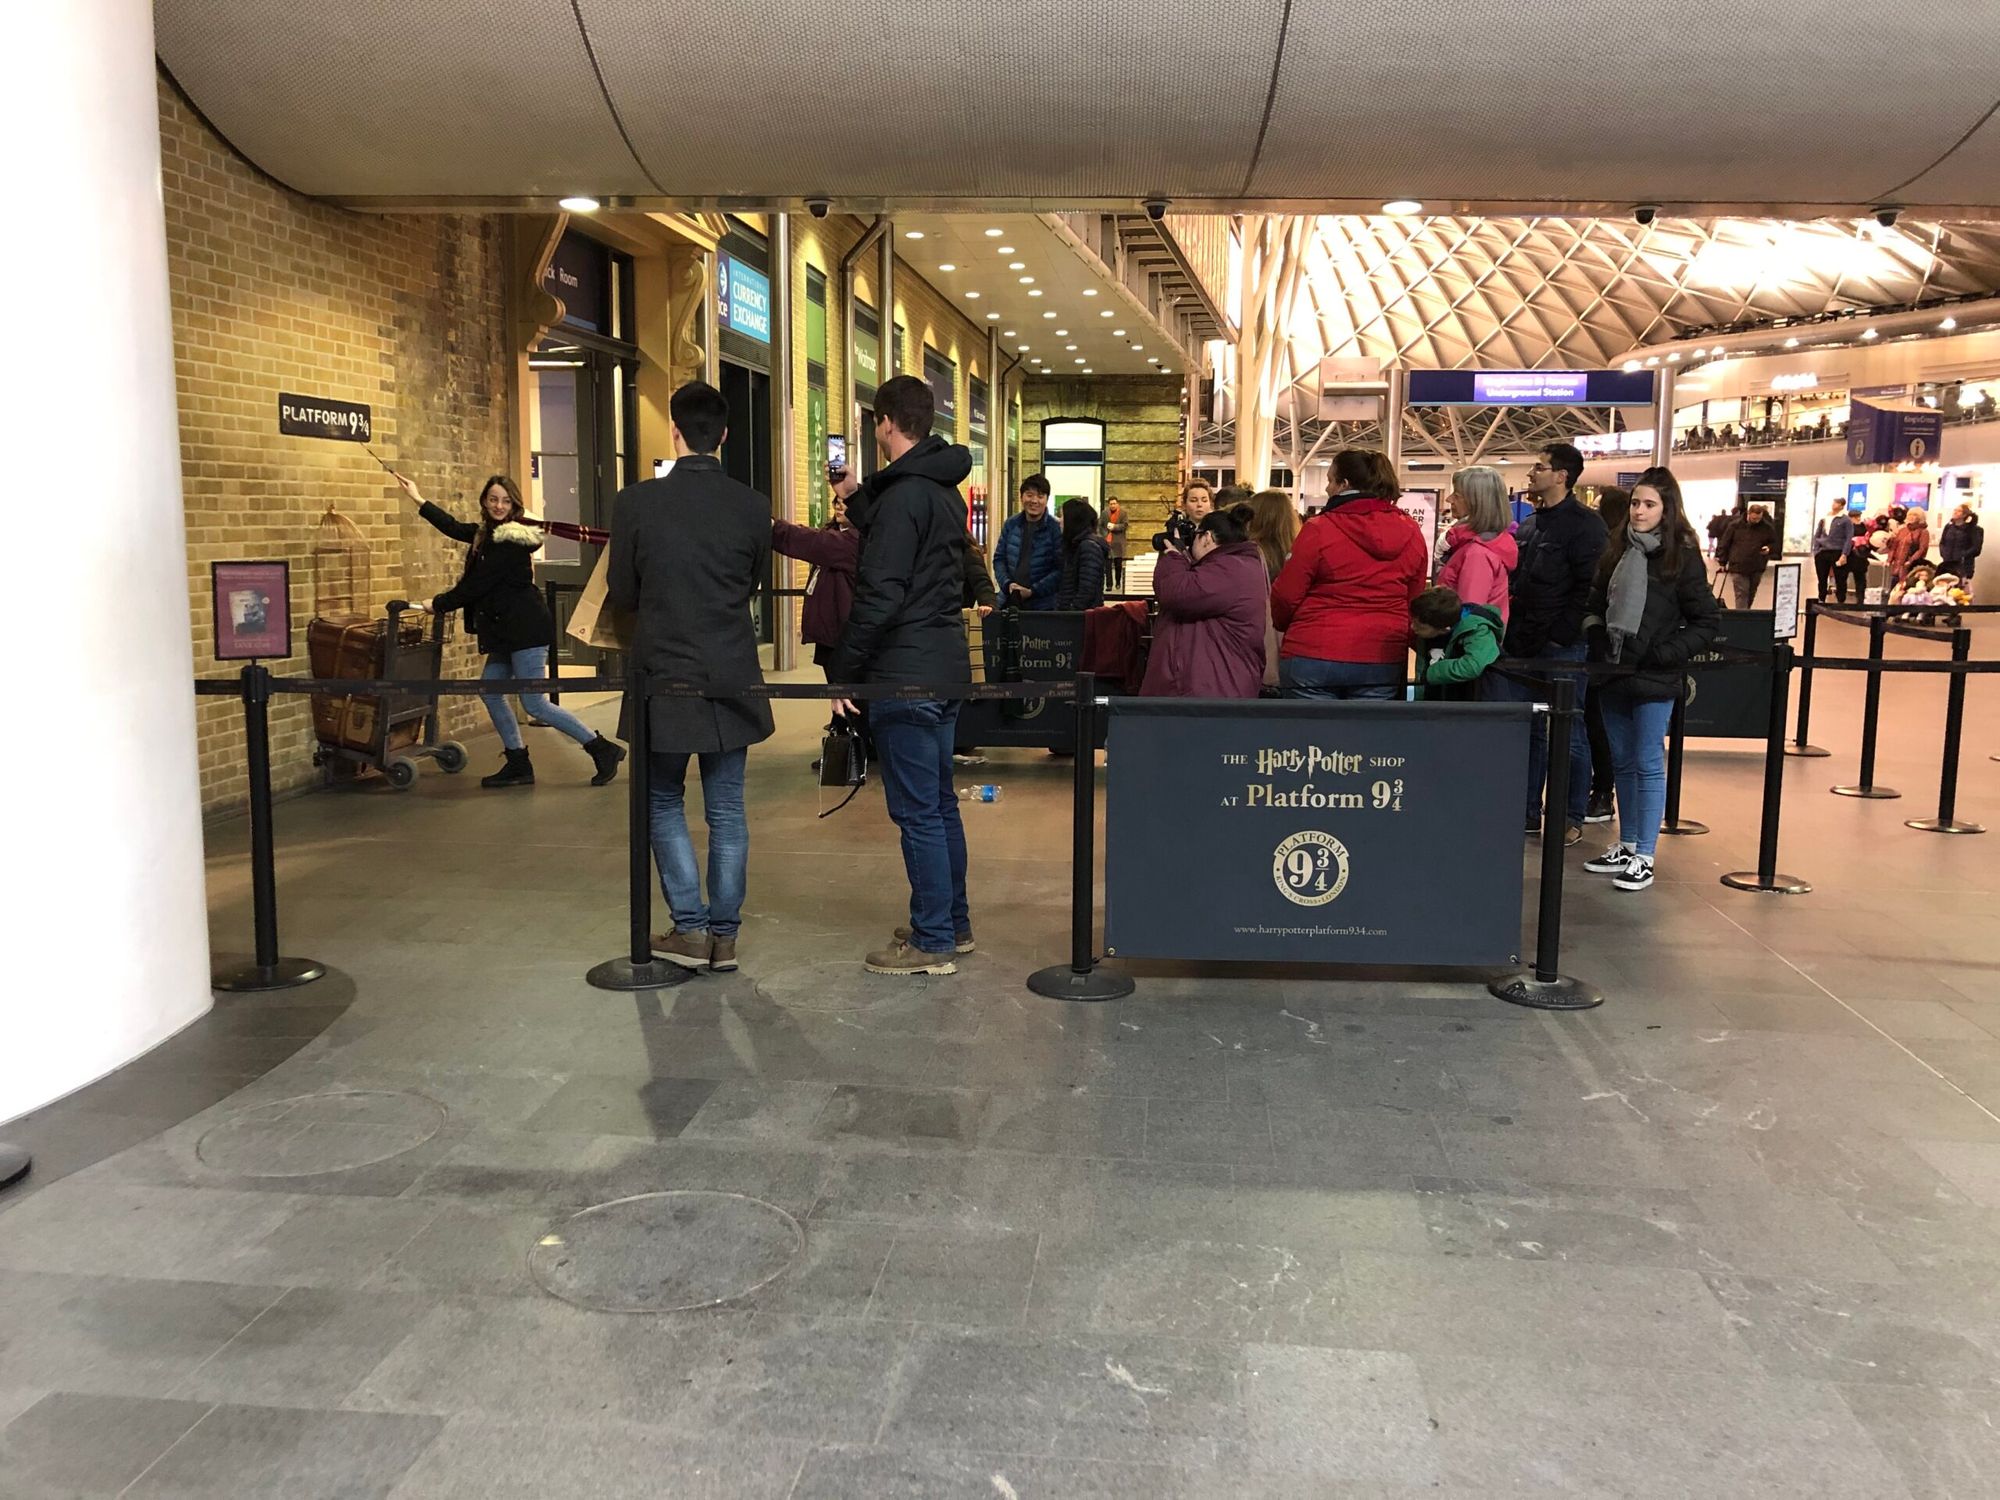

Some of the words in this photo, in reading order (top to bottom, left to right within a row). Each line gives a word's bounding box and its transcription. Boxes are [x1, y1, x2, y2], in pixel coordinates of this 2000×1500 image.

[559, 267, 578, 288] Room
[733, 281, 767, 313] CURRENCY
[733, 303, 767, 335] EXCHANGE
[1543, 388, 1574, 396] Station
[282, 405, 348, 427] PLATFORM
[1022, 635, 1051, 651] Potter
[1221, 754, 1248, 765] THE
[1255, 748, 1306, 776] Harry
[1308, 745, 1364, 780] Potter
[1369, 757, 1406, 767] SHOP
[1220, 796, 1239, 807] AT
[1246, 783, 1364, 809] Platform
[1277, 832, 1346, 857] PLATFORM
[1233, 924, 1387, 937] www.harrypotterplatform934.com
